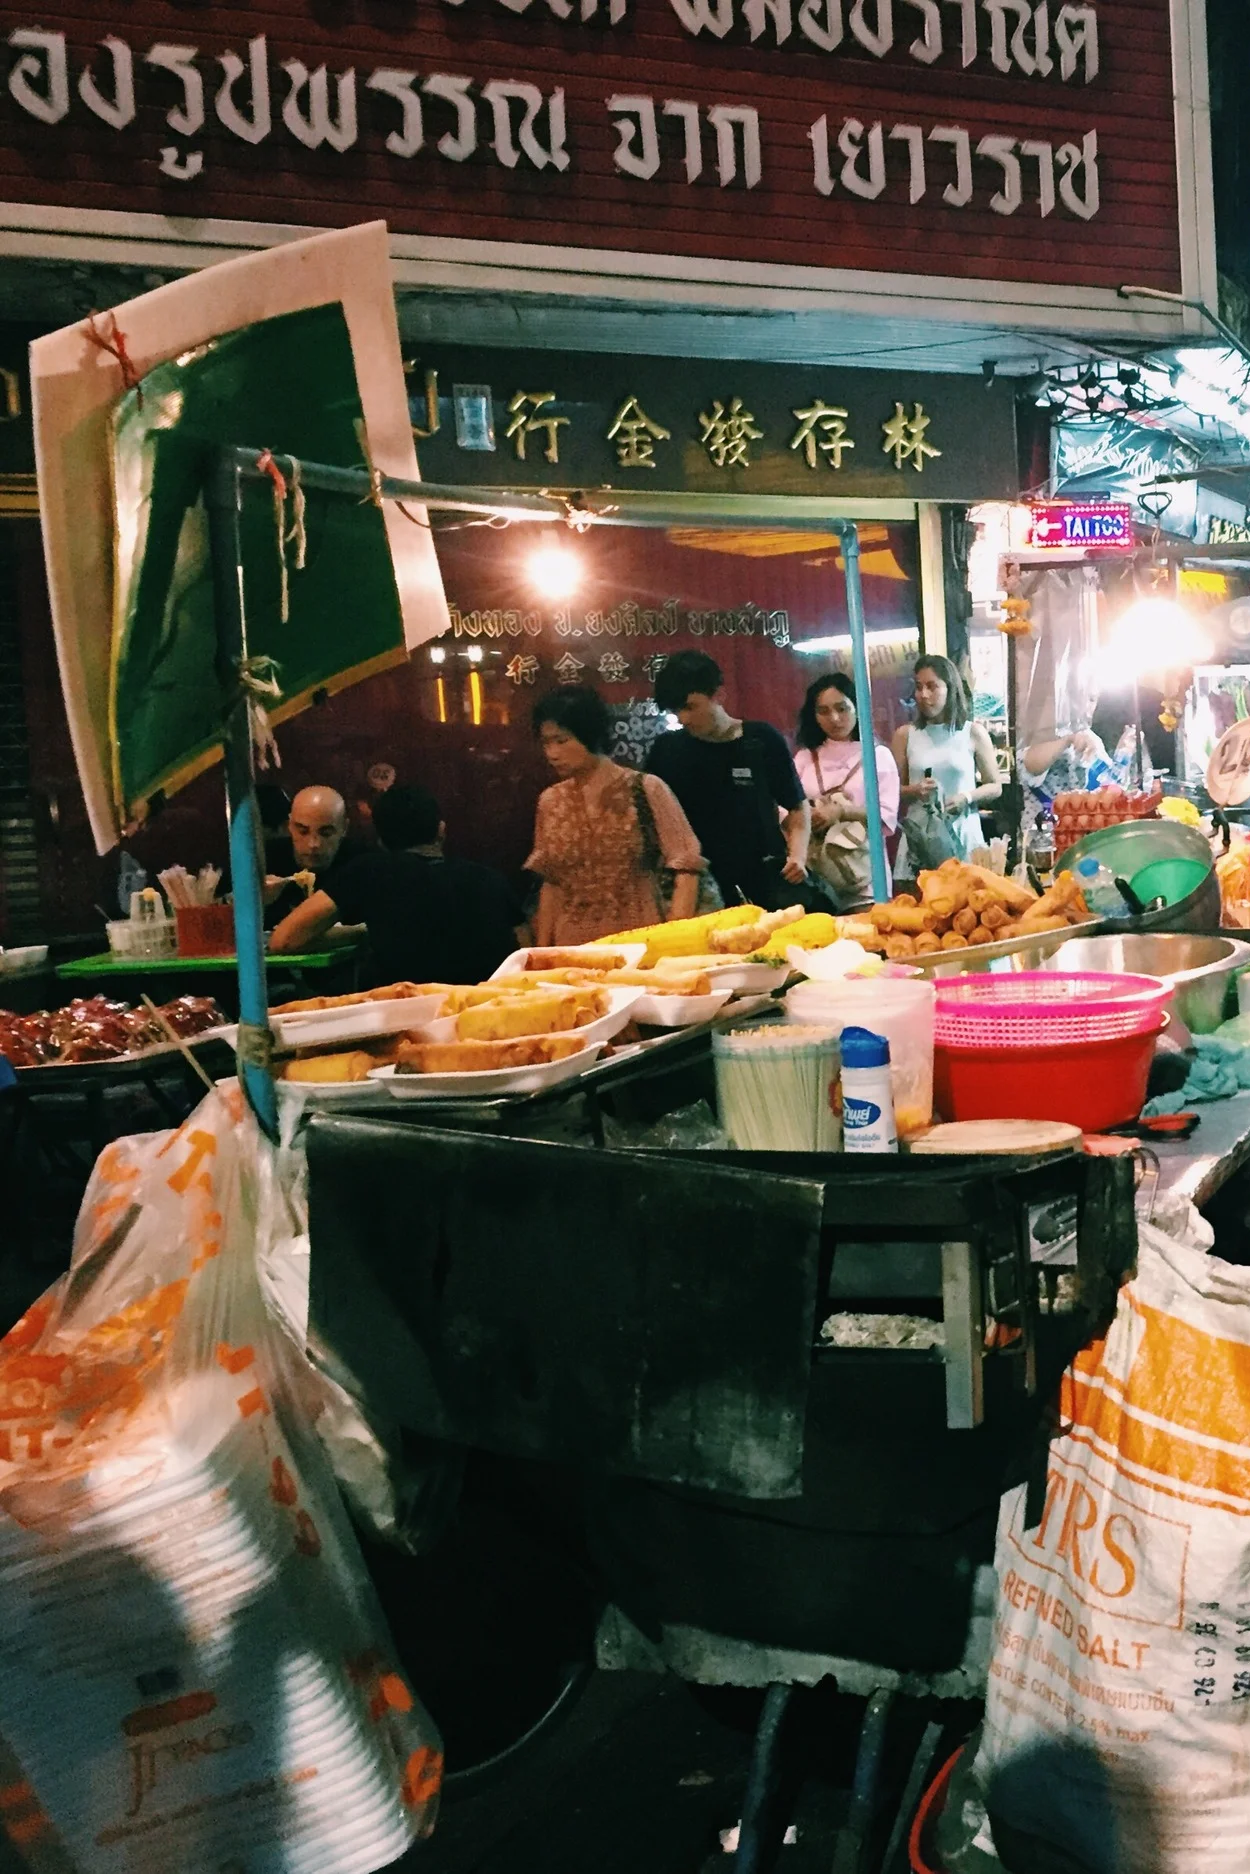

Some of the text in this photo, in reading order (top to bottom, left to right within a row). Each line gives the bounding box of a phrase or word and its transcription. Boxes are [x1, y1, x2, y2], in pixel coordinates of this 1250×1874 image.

[606, 94, 762, 190] จาก
[807, 114, 1100, 220] เยาวราช
[440, 602, 542, 638] ้างทอง
[1003, 1567, 1074, 1639] REFNED
[1077, 1623, 1150, 1672] SALT
